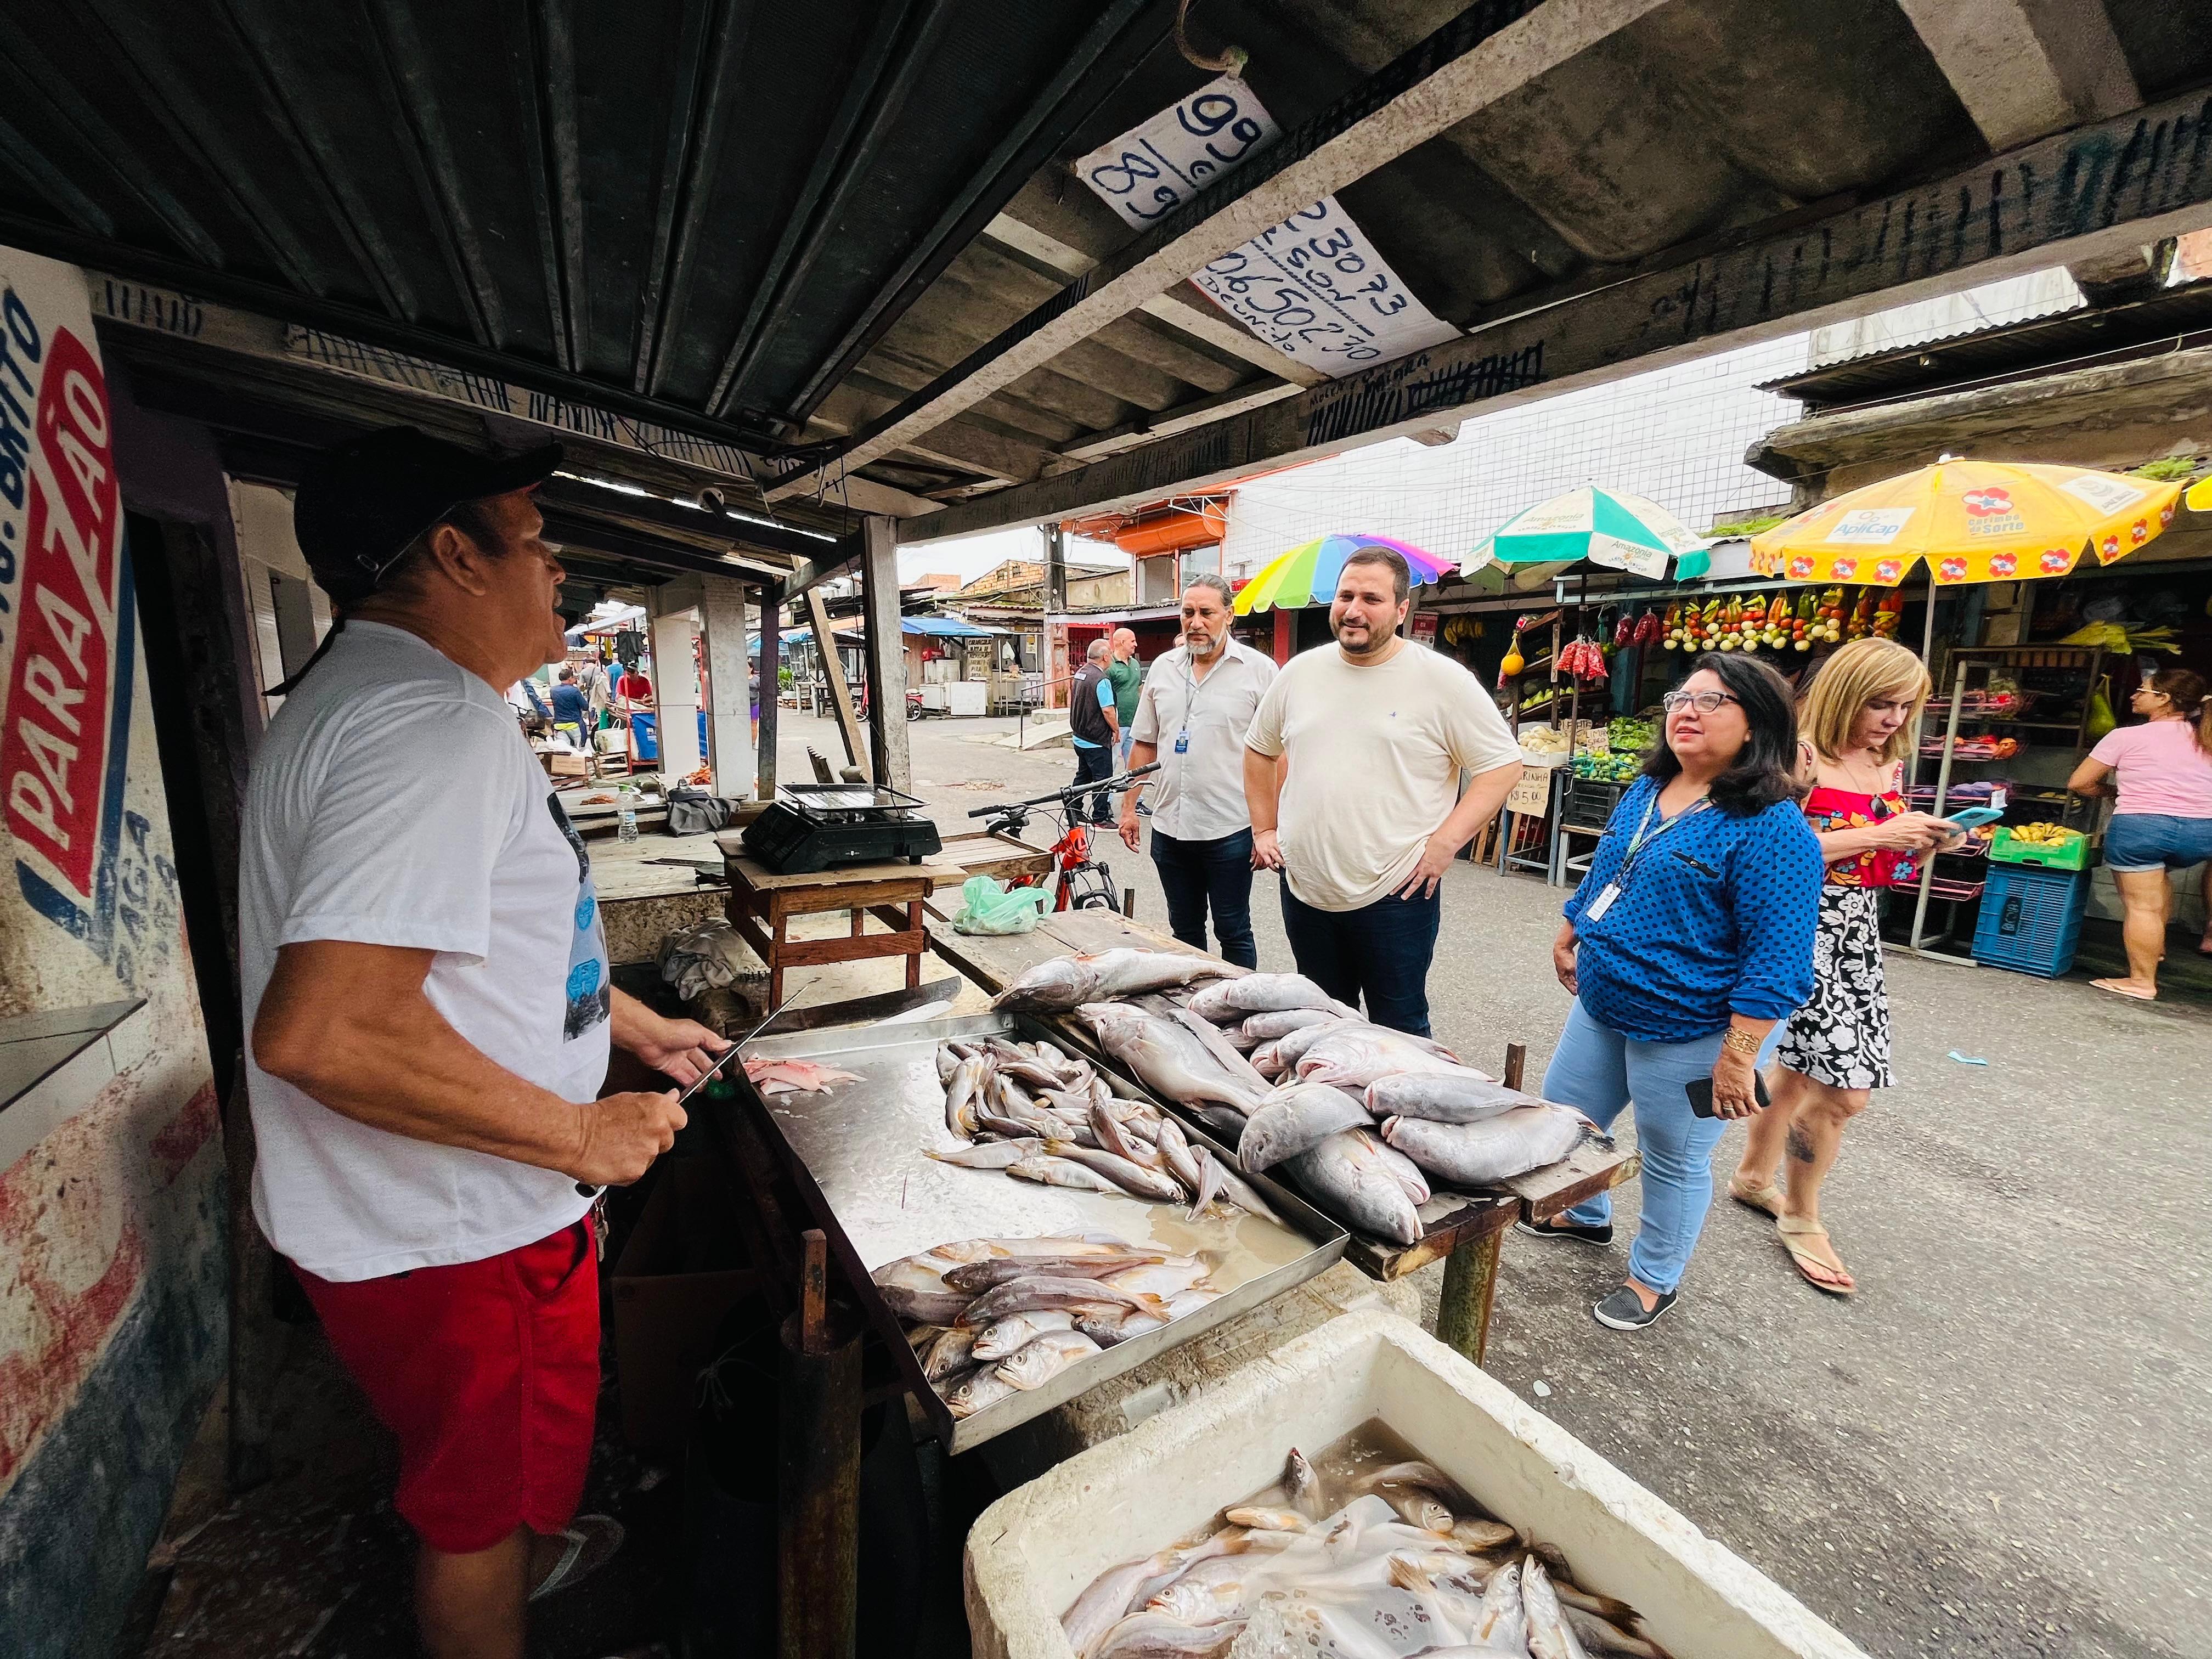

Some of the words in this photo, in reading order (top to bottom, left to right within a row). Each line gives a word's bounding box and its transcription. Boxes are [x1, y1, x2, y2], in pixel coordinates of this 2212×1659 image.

[1833, 523, 1900, 536] ApliCap
[1611, 540, 1652, 558] Amazonia
[9, 365, 109, 851] PARAZÃO
[1520, 769, 1548, 782] RINHA
